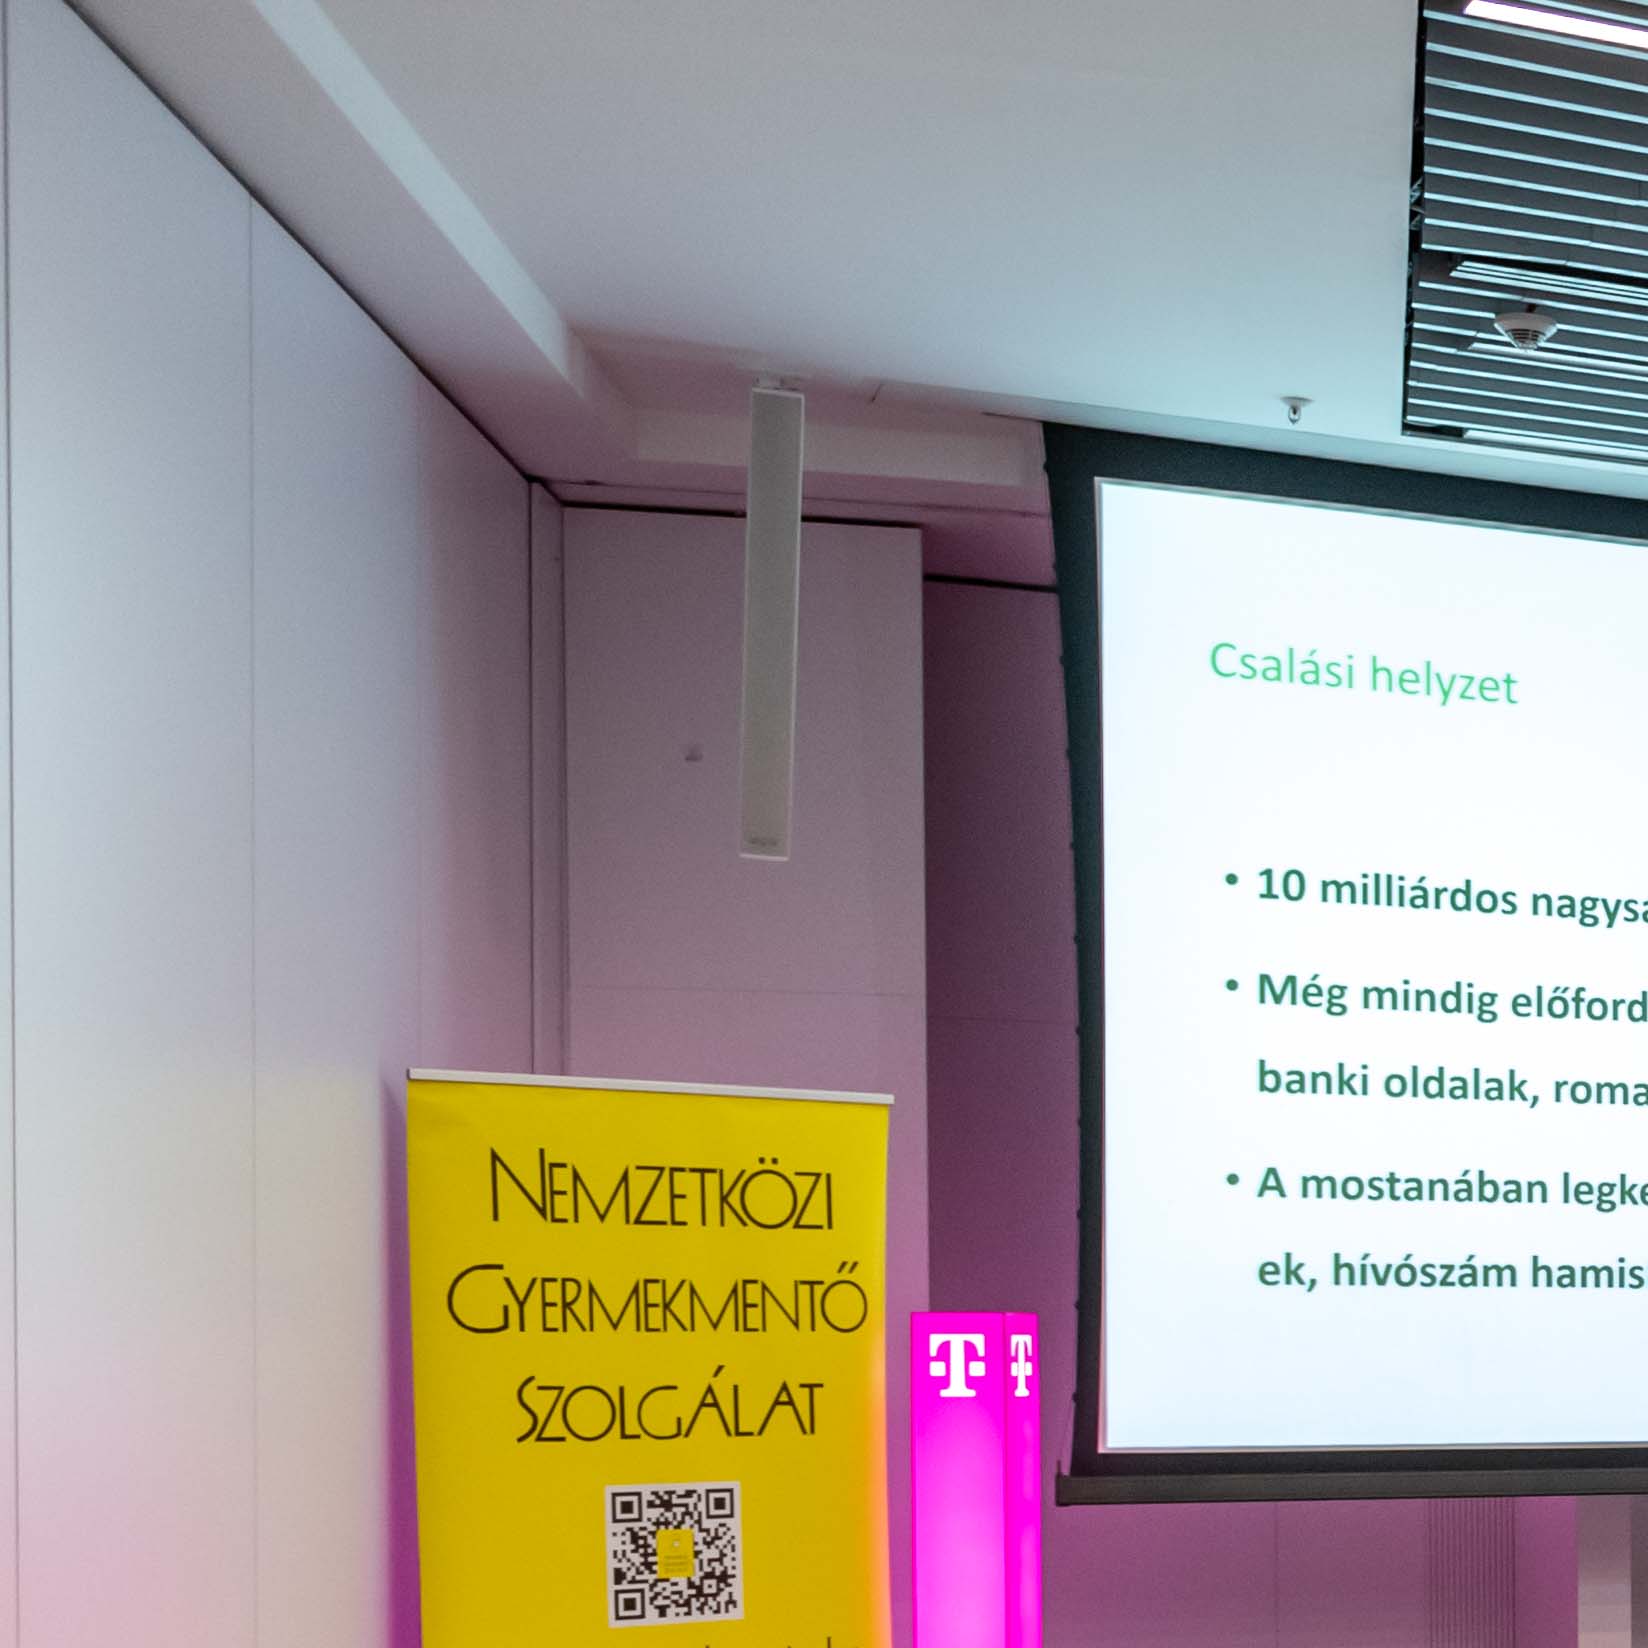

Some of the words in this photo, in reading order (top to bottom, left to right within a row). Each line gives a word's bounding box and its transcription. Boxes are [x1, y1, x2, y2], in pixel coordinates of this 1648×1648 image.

[1208, 641, 1355, 689] Csalási
[1371, 655, 1518, 707] helyzet
[1259, 867, 1307, 902] 10
[1320, 872, 1518, 916] milliárdos
[1258, 972, 1349, 1017] Még
[1362, 978, 1499, 1024] mindig
[1258, 1058, 1369, 1097] banki
[1383, 1064, 1540, 1109] oldalak,
[490, 1147, 833, 1230] NEMZETKÖZI
[1256, 1166, 1288, 1199] A
[1300, 1168, 1548, 1204] mostanában
[447, 1261, 868, 1334] GYERMEKMENTŐ
[1257, 1251, 1318, 1293] ek,
[1332, 1252, 1518, 1289] hívószám
[929, 1333, 985, 1397] T
[516, 1364, 824, 1443] SZOLGÁLAT
